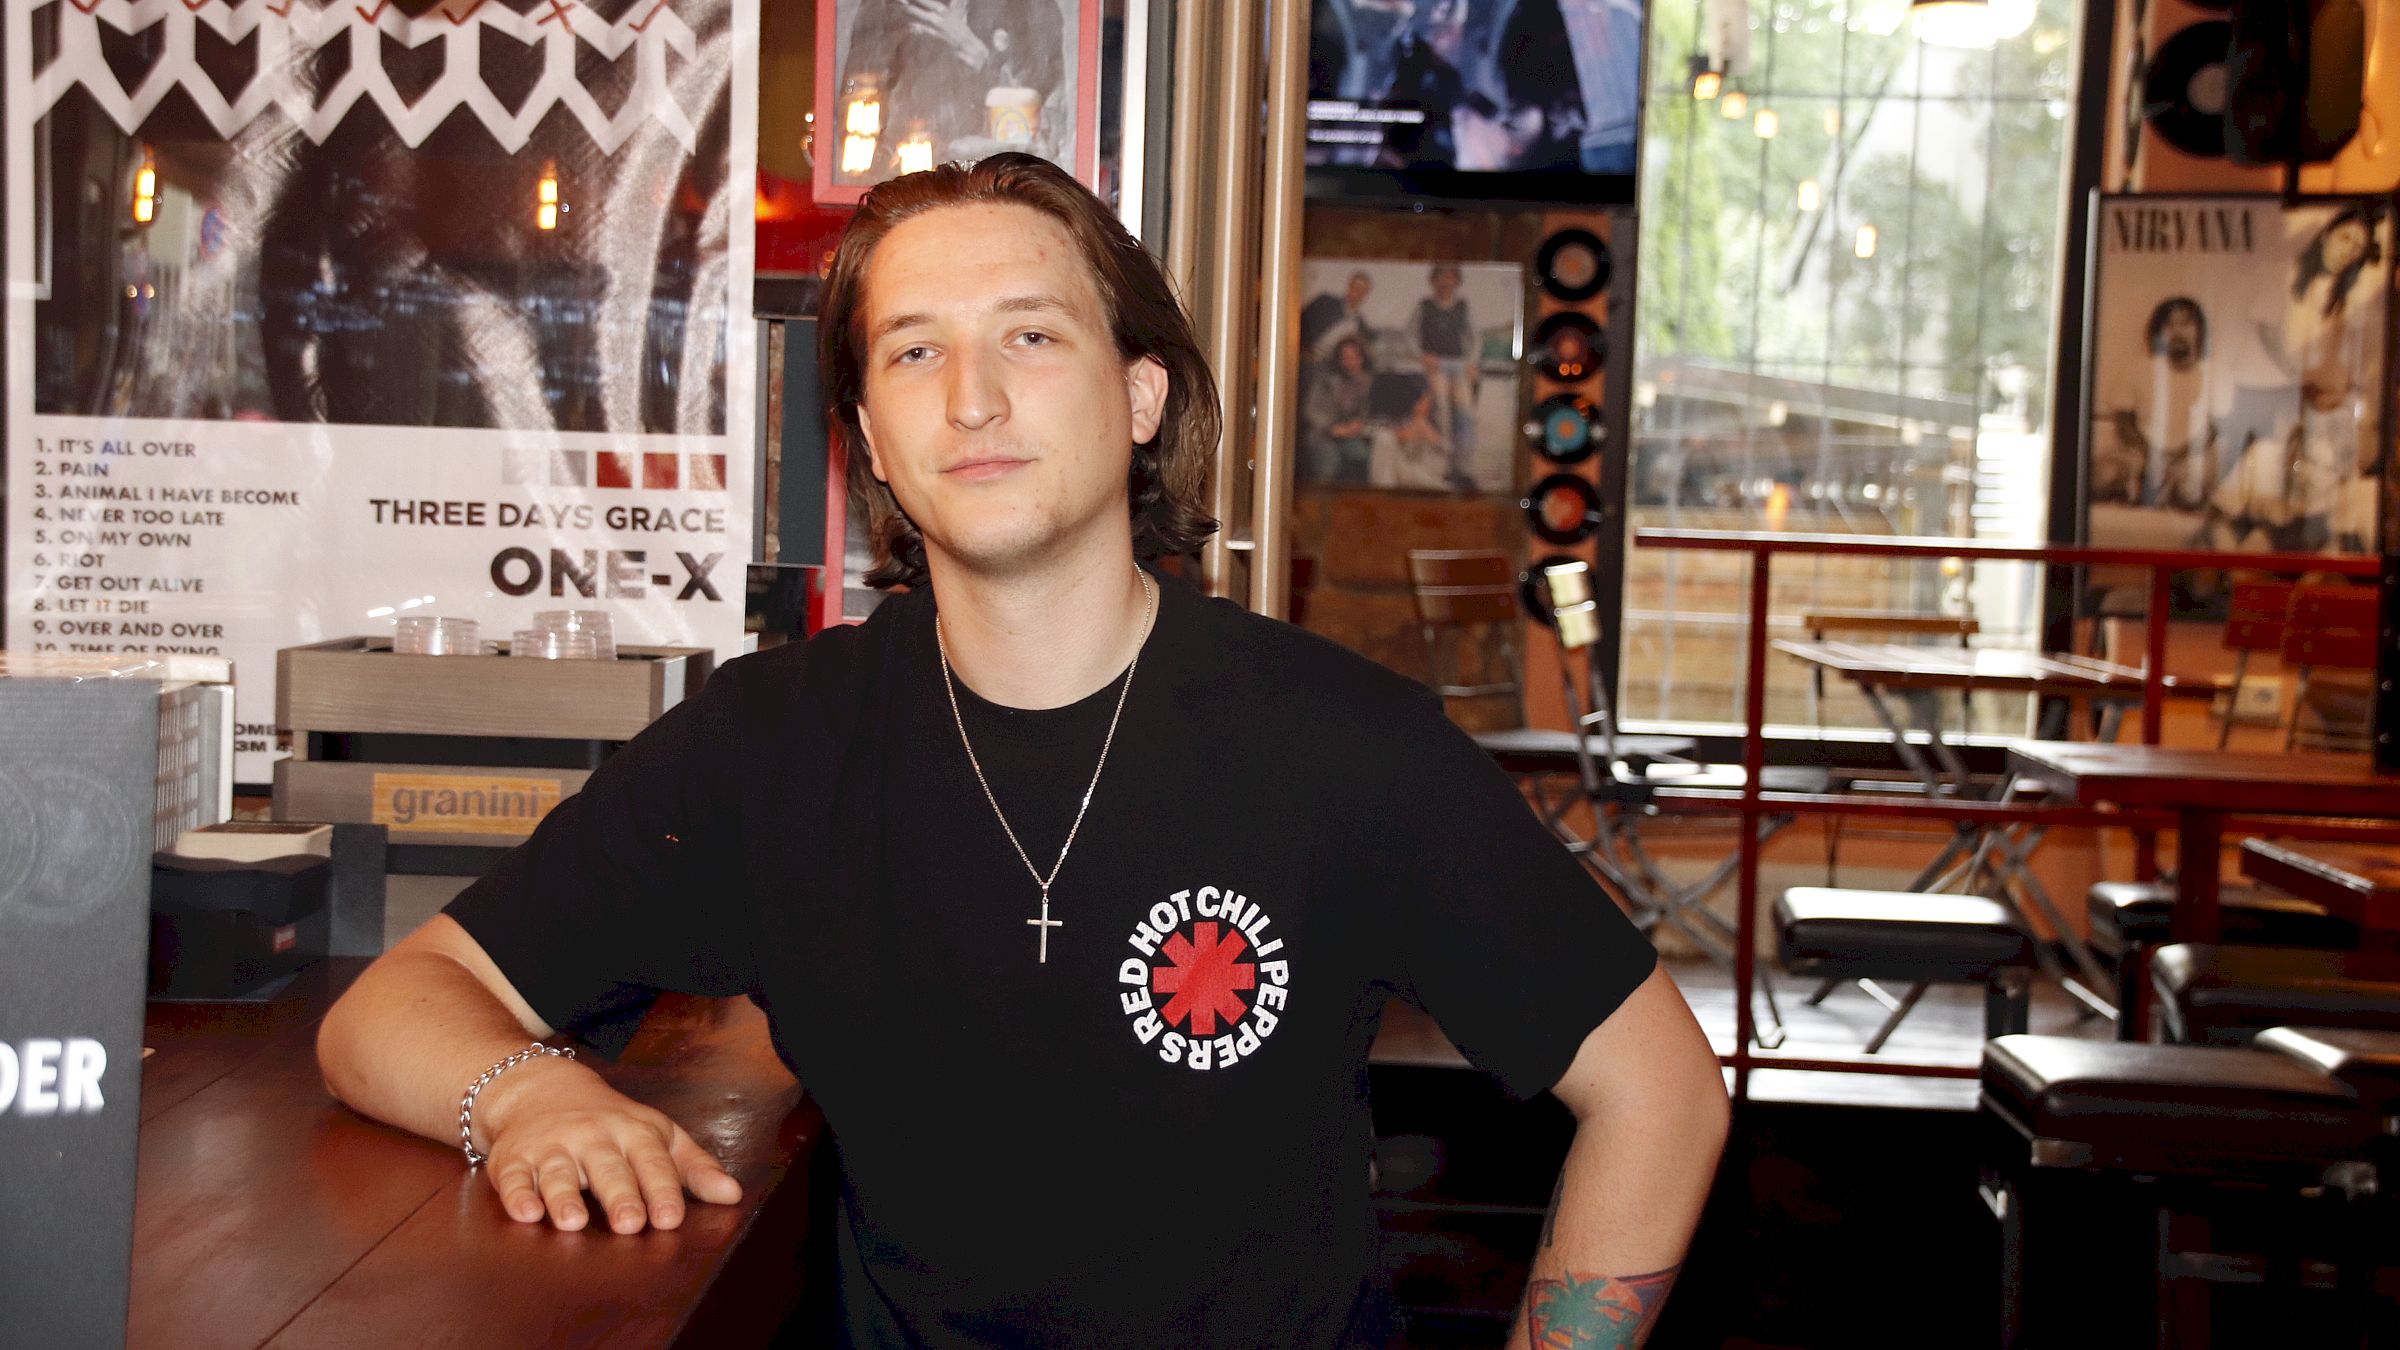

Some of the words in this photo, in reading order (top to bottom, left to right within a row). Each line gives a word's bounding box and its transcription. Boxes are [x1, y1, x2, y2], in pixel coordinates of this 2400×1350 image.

[2113, 208, 2253, 253] NIRVANA
[36, 438, 52, 453] 1.
[59, 439, 95, 455] IT'S
[101, 440, 136, 456] ALL
[142, 441, 196, 458] OVER
[35, 460, 52, 476] 2.
[60, 461, 109, 478] PAIN
[34, 483, 52, 498] 3.
[60, 485, 143, 501] ANIMAL
[148, 487, 155, 502] I
[161, 487, 215, 504] HAVE
[221, 489, 301, 506] BECOME
[33, 507, 52, 522] 4.
[60, 507, 125, 524] NEVER
[132, 509, 175, 525] TOO
[182, 511, 225, 526] LATE
[370, 499, 486, 527] THREE
[499, 502, 595, 530] DAYS
[605, 506, 725, 533] GRACE
[35, 530, 52, 544] 5.
[60, 530, 94, 546] ON
[101, 532, 131, 547] MY
[137, 532, 192, 548] OWN
[33, 553, 52, 567] 6.
[59, 553, 106, 569] RIOT
[57, 575, 93, 591] GET
[100, 576, 142, 592] OUT
[149, 578, 204, 593] ALIVE
[490, 546, 725, 602] ONE-X
[33, 598, 51, 612] 8.
[59, 598, 90, 613] LET
[95, 599, 112, 613] IT
[119, 600, 150, 614] DIE
[33, 620, 52, 635] 9.
[59, 620, 113, 636] OVER
[120, 622, 163, 638] AND
[171, 623, 225, 639] OVER
[392, 785, 540, 824] granini
[1128, 888, 1192, 958] HOT
[1196, 885, 1284, 958] CHILI
[1118, 957, 1165, 1046] RED
[1159, 959, 1290, 1071] PEPPERS
